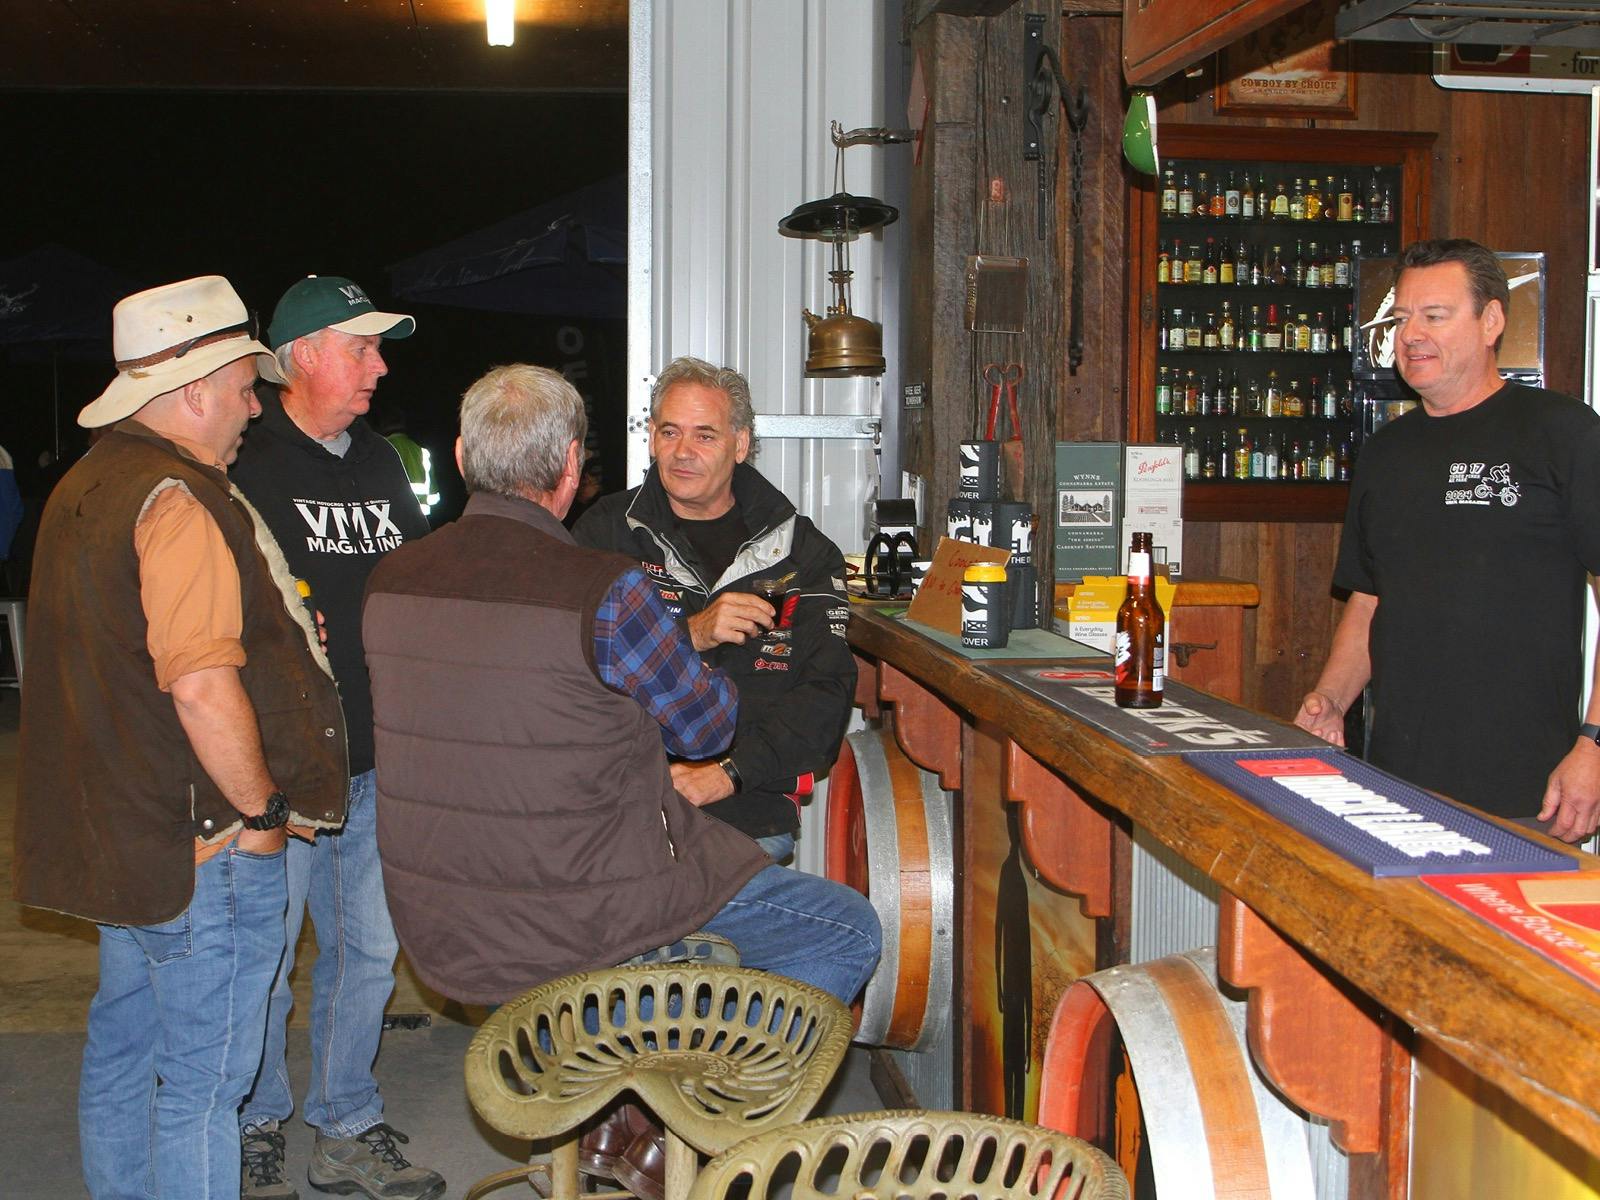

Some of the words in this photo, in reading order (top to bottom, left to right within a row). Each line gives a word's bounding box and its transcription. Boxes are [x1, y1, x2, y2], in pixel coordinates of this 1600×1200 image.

[1572, 51, 1599, 74] for
[1241, 78, 1282, 88] COWBOY
[1284, 80, 1298, 89] BY
[1301, 81, 1337, 90] CHOICE
[337, 285, 364, 299] VM
[1469, 463, 1485, 474] 17
[1073, 473, 1101, 481] WYNNS
[959, 491, 980, 499] OVER
[1445, 489, 1473, 501] 2024
[294, 503, 402, 540] VMX
[962, 637, 989, 647] OVER
[1344, 813, 1492, 858] LANE
[1456, 883, 1524, 915] Where
